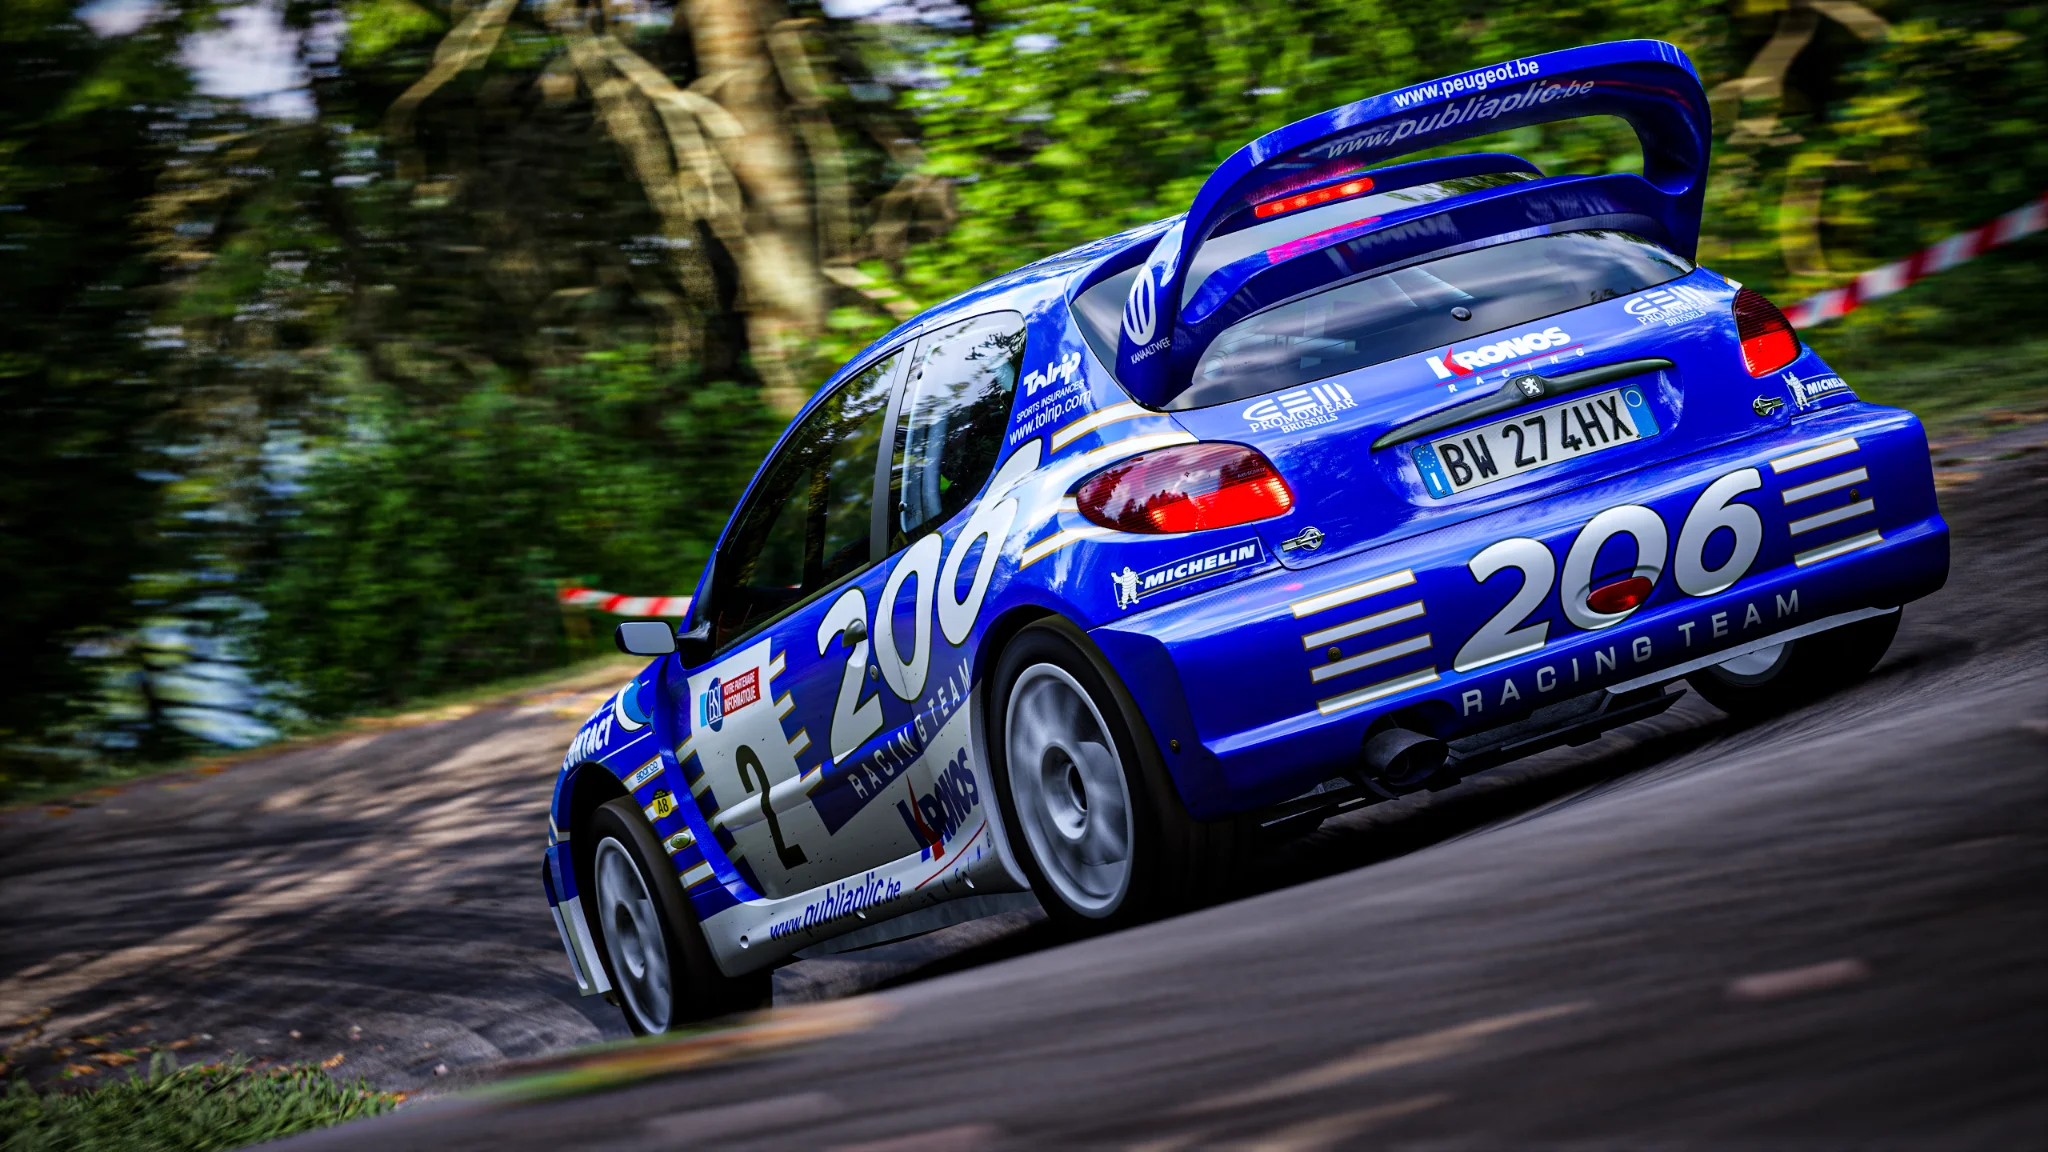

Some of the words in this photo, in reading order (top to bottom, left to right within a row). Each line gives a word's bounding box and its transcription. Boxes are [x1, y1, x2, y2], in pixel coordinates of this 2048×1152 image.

[1394, 60, 1539, 108] www.peugeot.be
[1327, 80, 1594, 158] www.publiaplic.be
[1636, 297, 1715, 326] PROMOWEAR
[1665, 309, 1706, 327] BRUSSELS
[1130, 337, 1171, 364] KANAALTWEE
[1426, 326, 1571, 380] KRONOS
[1448, 347, 1585, 393] RACING
[1023, 352, 1081, 397] Tolrip
[1806, 378, 1848, 395] MICHELI
[1009, 390, 1091, 446] www.tolrip.com
[1016, 401, 1040, 423] SPORTS
[1041, 378, 1085, 408] INSURANCES
[1249, 398, 1358, 433] PROMOWEAR
[1281, 413, 1338, 434] BRUSSELS
[1438, 433, 1498, 487] BW
[1144, 544, 1255, 590] MICHELIN
[1453, 467, 1763, 674] 206
[817, 438, 1043, 766] 206
[1462, 636, 1652, 717] RACING
[1678, 589, 1800, 648] TEAM
[724, 685, 757, 713] INFORMATIQUE
[848, 714, 928, 799] RACING
[928, 658, 972, 725] TEAM
[636, 761, 659, 781] sparco
[657, 798, 669, 814] A8
[736, 744, 808, 870] 2
[897, 747, 979, 863] KRONOS
[769, 871, 901, 940] www.publiaplic.be
